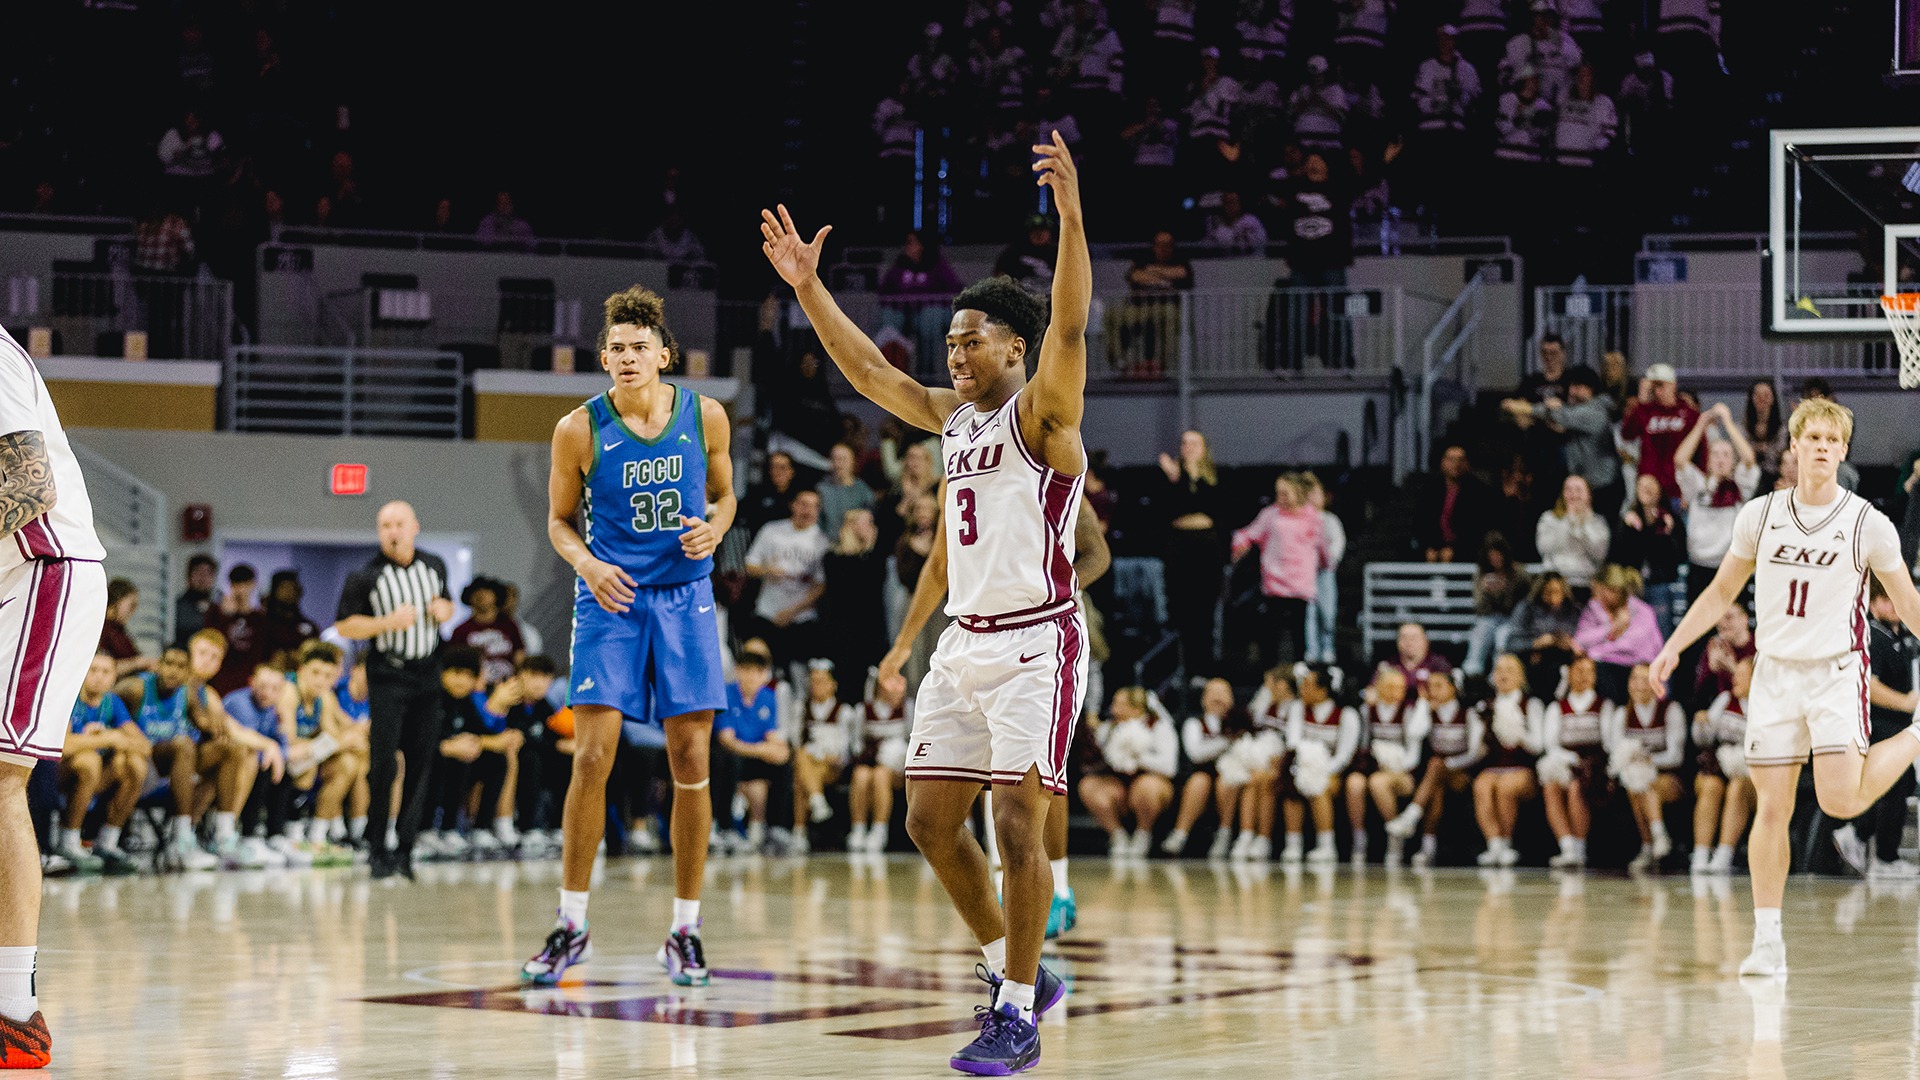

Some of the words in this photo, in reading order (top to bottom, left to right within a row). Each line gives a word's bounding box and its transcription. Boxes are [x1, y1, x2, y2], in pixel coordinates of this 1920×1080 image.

[623, 454, 683, 489] FGCU
[947, 443, 1004, 476] EKU
[629, 488, 684, 533] 32
[956, 487, 979, 547] 3
[1773, 544, 1839, 567] EKU
[1786, 578, 1809, 618] 11
[914, 742, 932, 757] E
